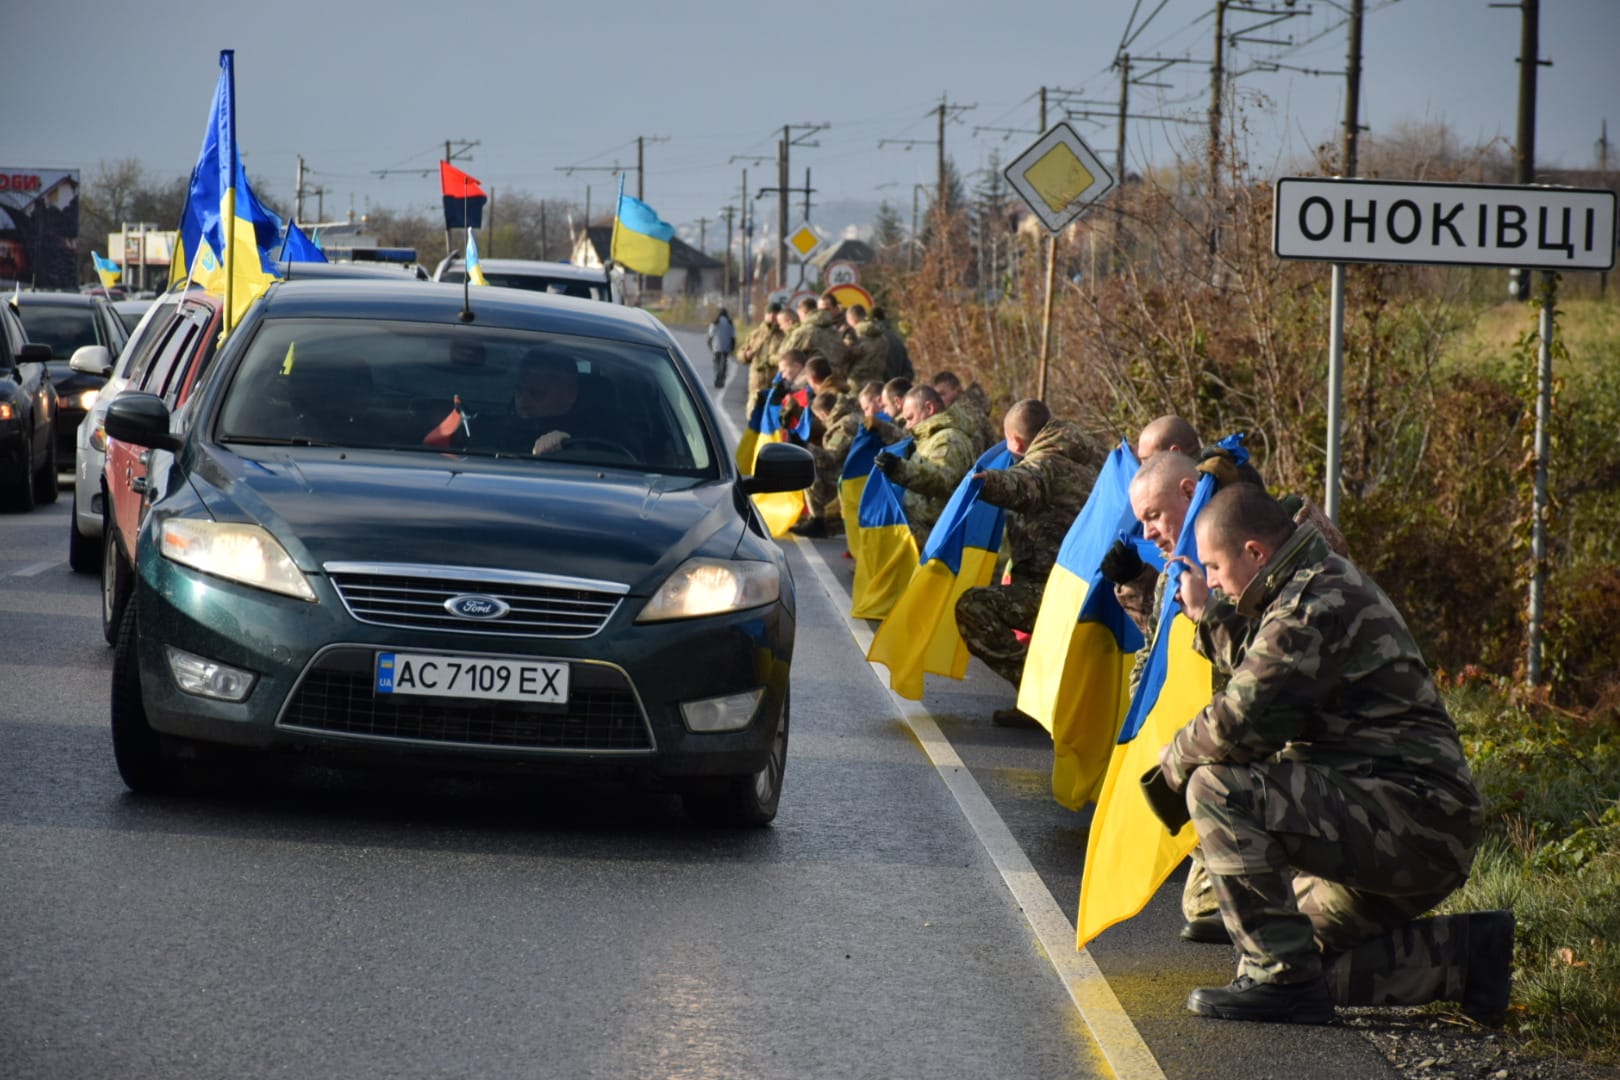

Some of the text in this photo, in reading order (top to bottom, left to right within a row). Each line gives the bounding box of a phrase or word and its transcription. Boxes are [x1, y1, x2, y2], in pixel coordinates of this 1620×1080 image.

[1299, 196, 1594, 259] ОНОКІВЦІ
[463, 601, 491, 613] Ford
[379, 678, 392, 688] UA
[397, 661, 560, 695] AC 7109 EX
